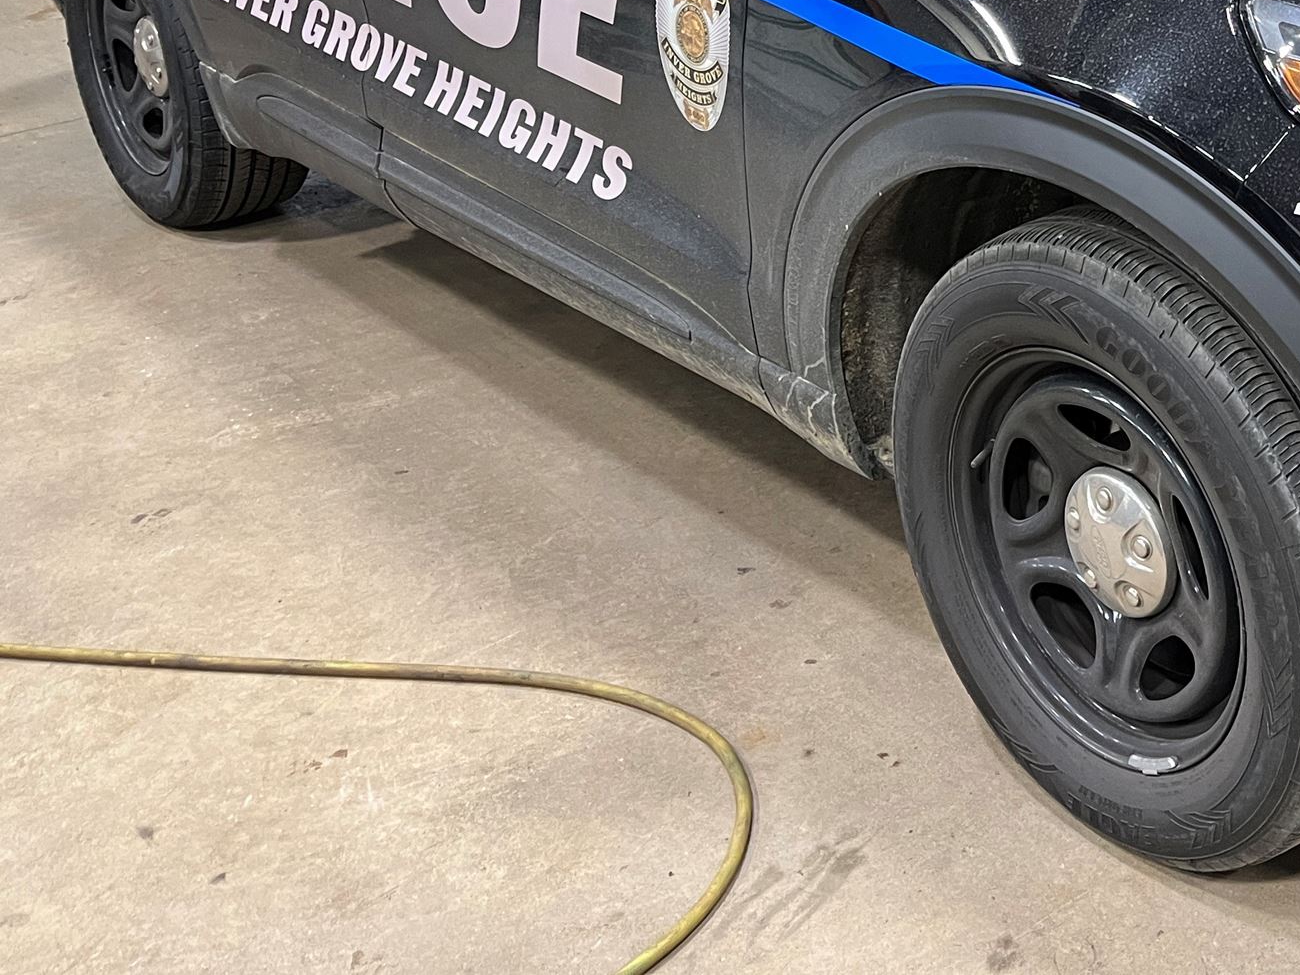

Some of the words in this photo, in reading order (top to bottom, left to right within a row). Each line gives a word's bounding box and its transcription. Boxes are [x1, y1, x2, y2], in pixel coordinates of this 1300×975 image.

[663, 42, 692, 80] INVER
[693, 65, 722, 85] GROVE
[301, 0, 428, 98] GROVE
[423, 60, 634, 201] HEIGHTS
[676, 79, 712, 105] HEIGHTS
